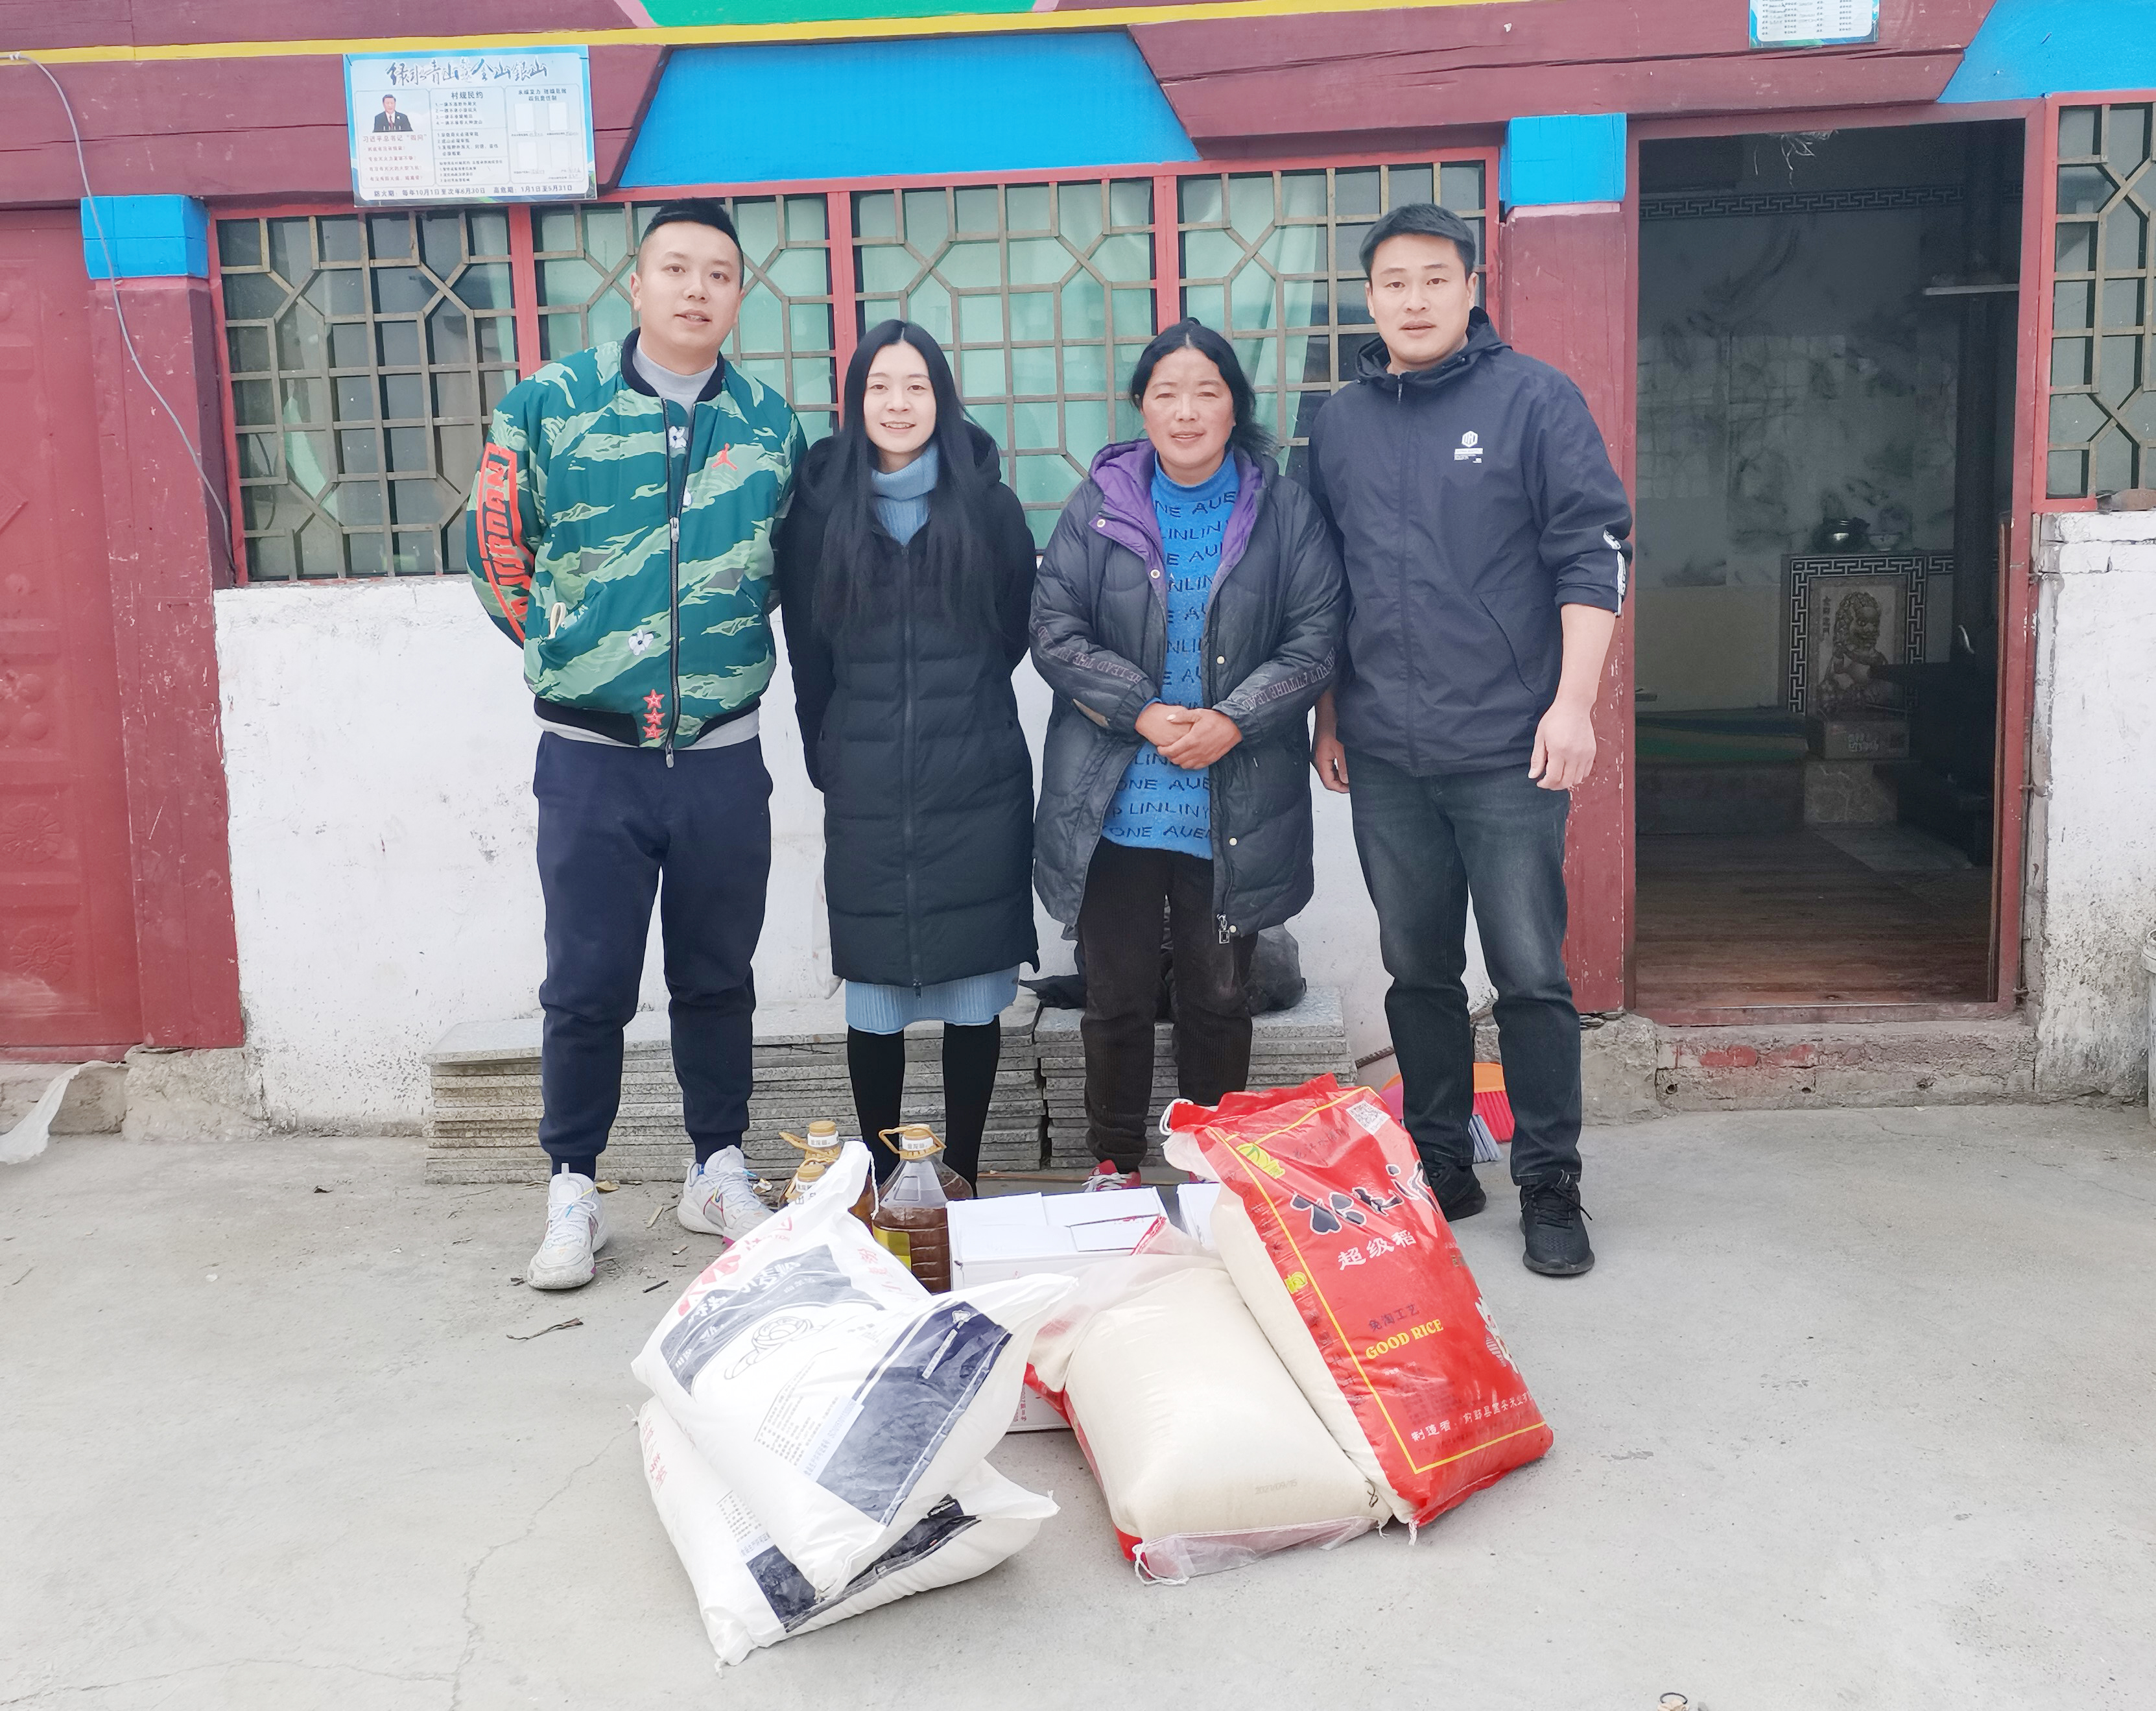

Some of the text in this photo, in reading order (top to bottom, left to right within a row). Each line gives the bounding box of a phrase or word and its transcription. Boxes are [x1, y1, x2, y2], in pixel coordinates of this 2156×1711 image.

[1337, 1228, 1418, 1271] 超级稻
[1366, 1319, 1444, 1361] GOOD RICE
